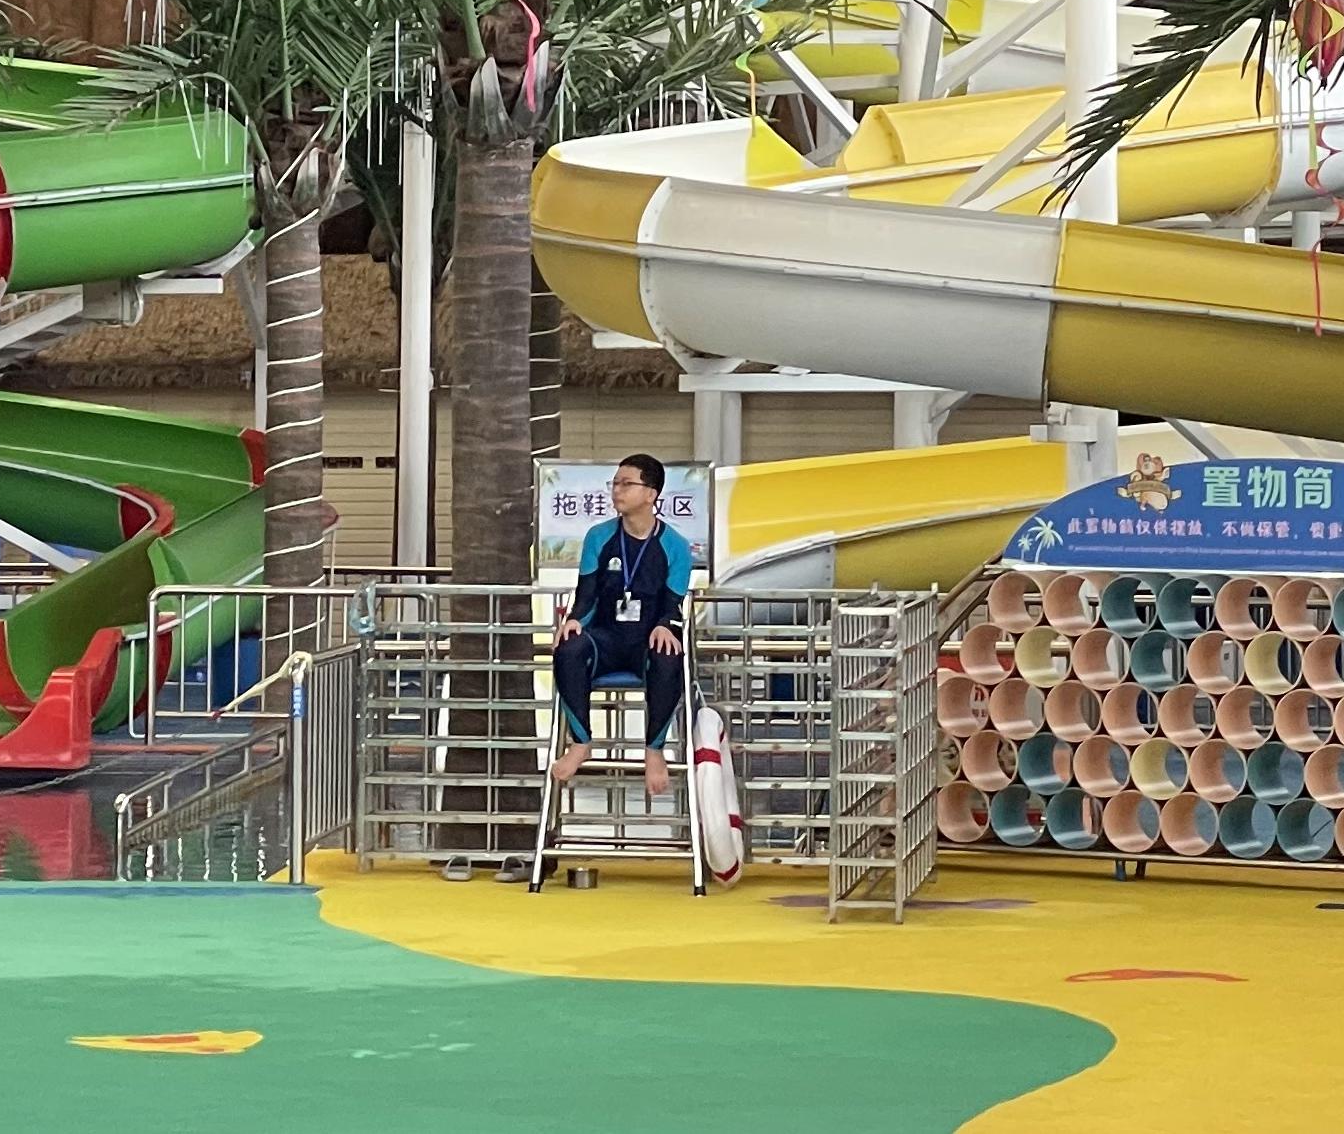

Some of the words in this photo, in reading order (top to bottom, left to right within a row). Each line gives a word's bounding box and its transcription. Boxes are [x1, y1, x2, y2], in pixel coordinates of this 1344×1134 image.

[1202, 466, 1333, 509] 置物筒
[553, 493, 694, 517] 拖鞋区
